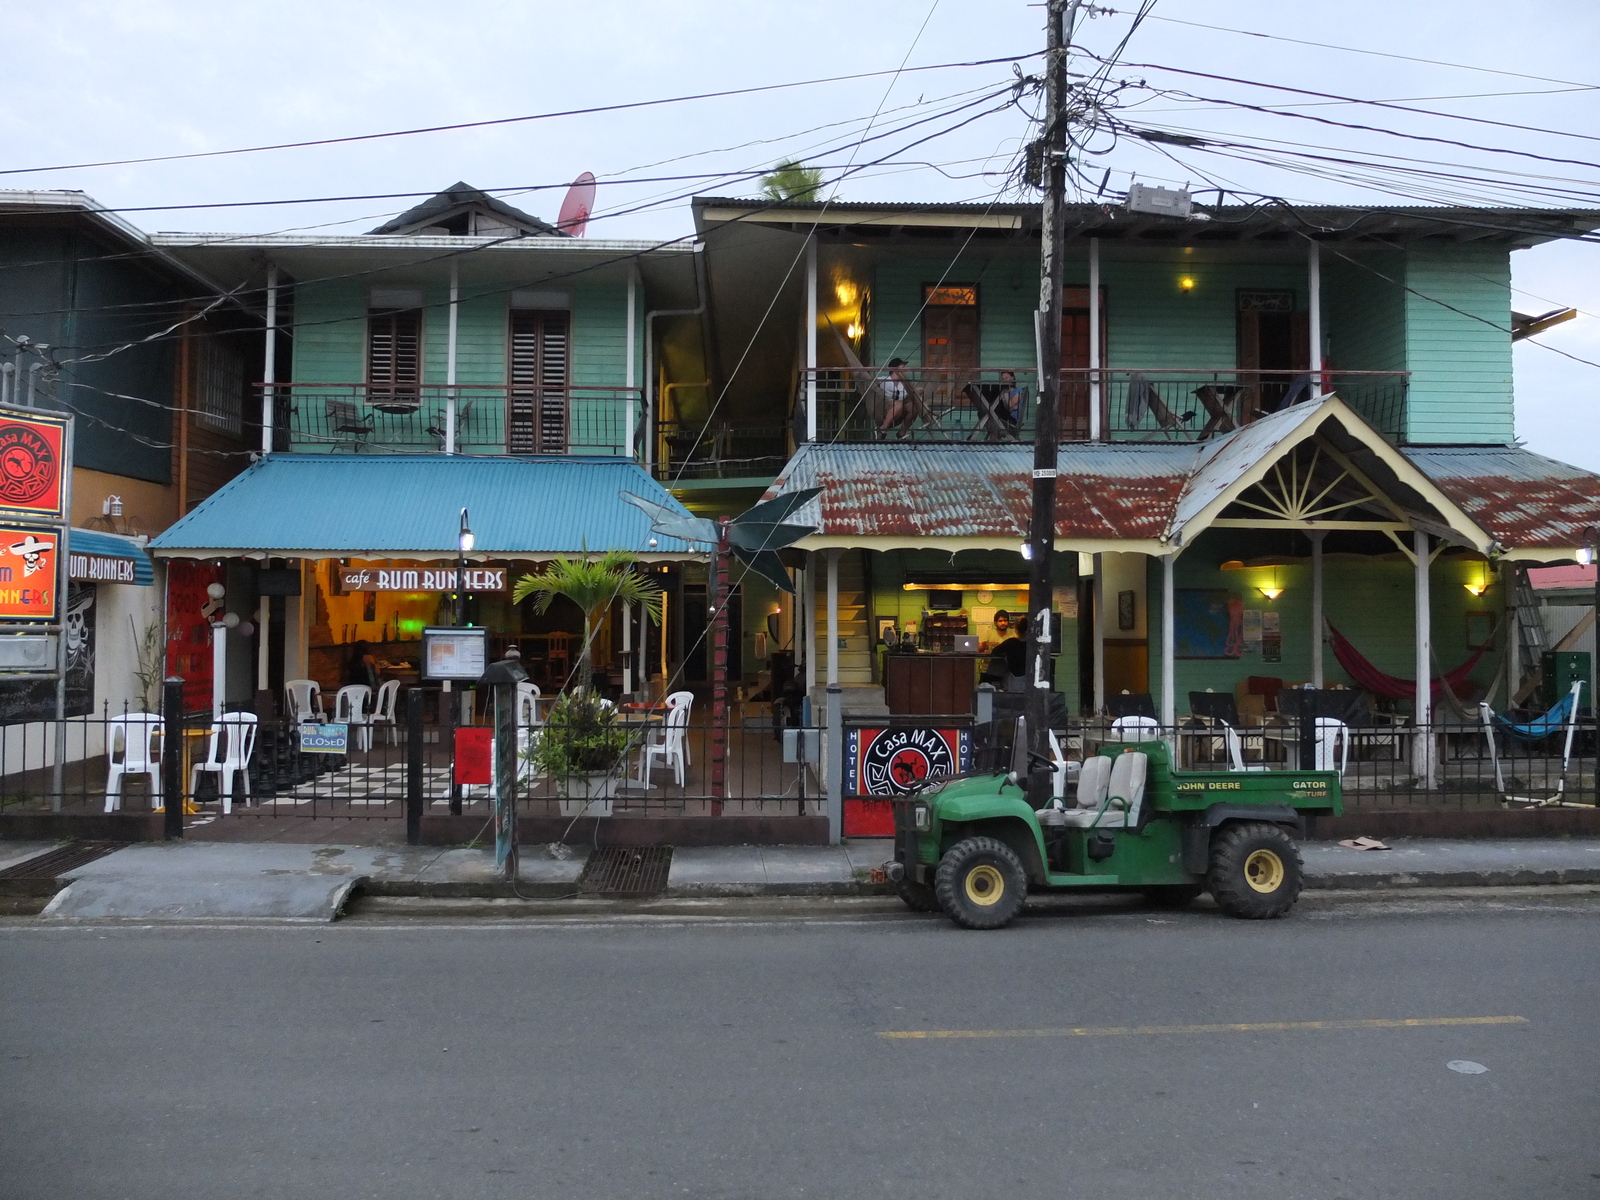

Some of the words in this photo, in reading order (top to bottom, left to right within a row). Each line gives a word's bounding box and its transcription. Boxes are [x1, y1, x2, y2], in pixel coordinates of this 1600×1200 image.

[20, 432, 49, 459] MAX
[69, 555, 88, 578] UM
[88, 556, 134, 582] RUNNERS
[345, 569, 371, 590] café
[376, 570, 418, 589] RUM
[421, 571, 503, 589] RUNNERS
[302, 737, 345, 747] CLOSED
[875, 732, 907, 757] Casa
[910, 729, 946, 760] MAX
[960, 732, 968, 774] HOT
[849, 731, 857, 790] HOTEL
[1177, 782, 1205, 790] JOHN
[1208, 782, 1241, 790] DEERE
[1292, 781, 1326, 790] GATOR
